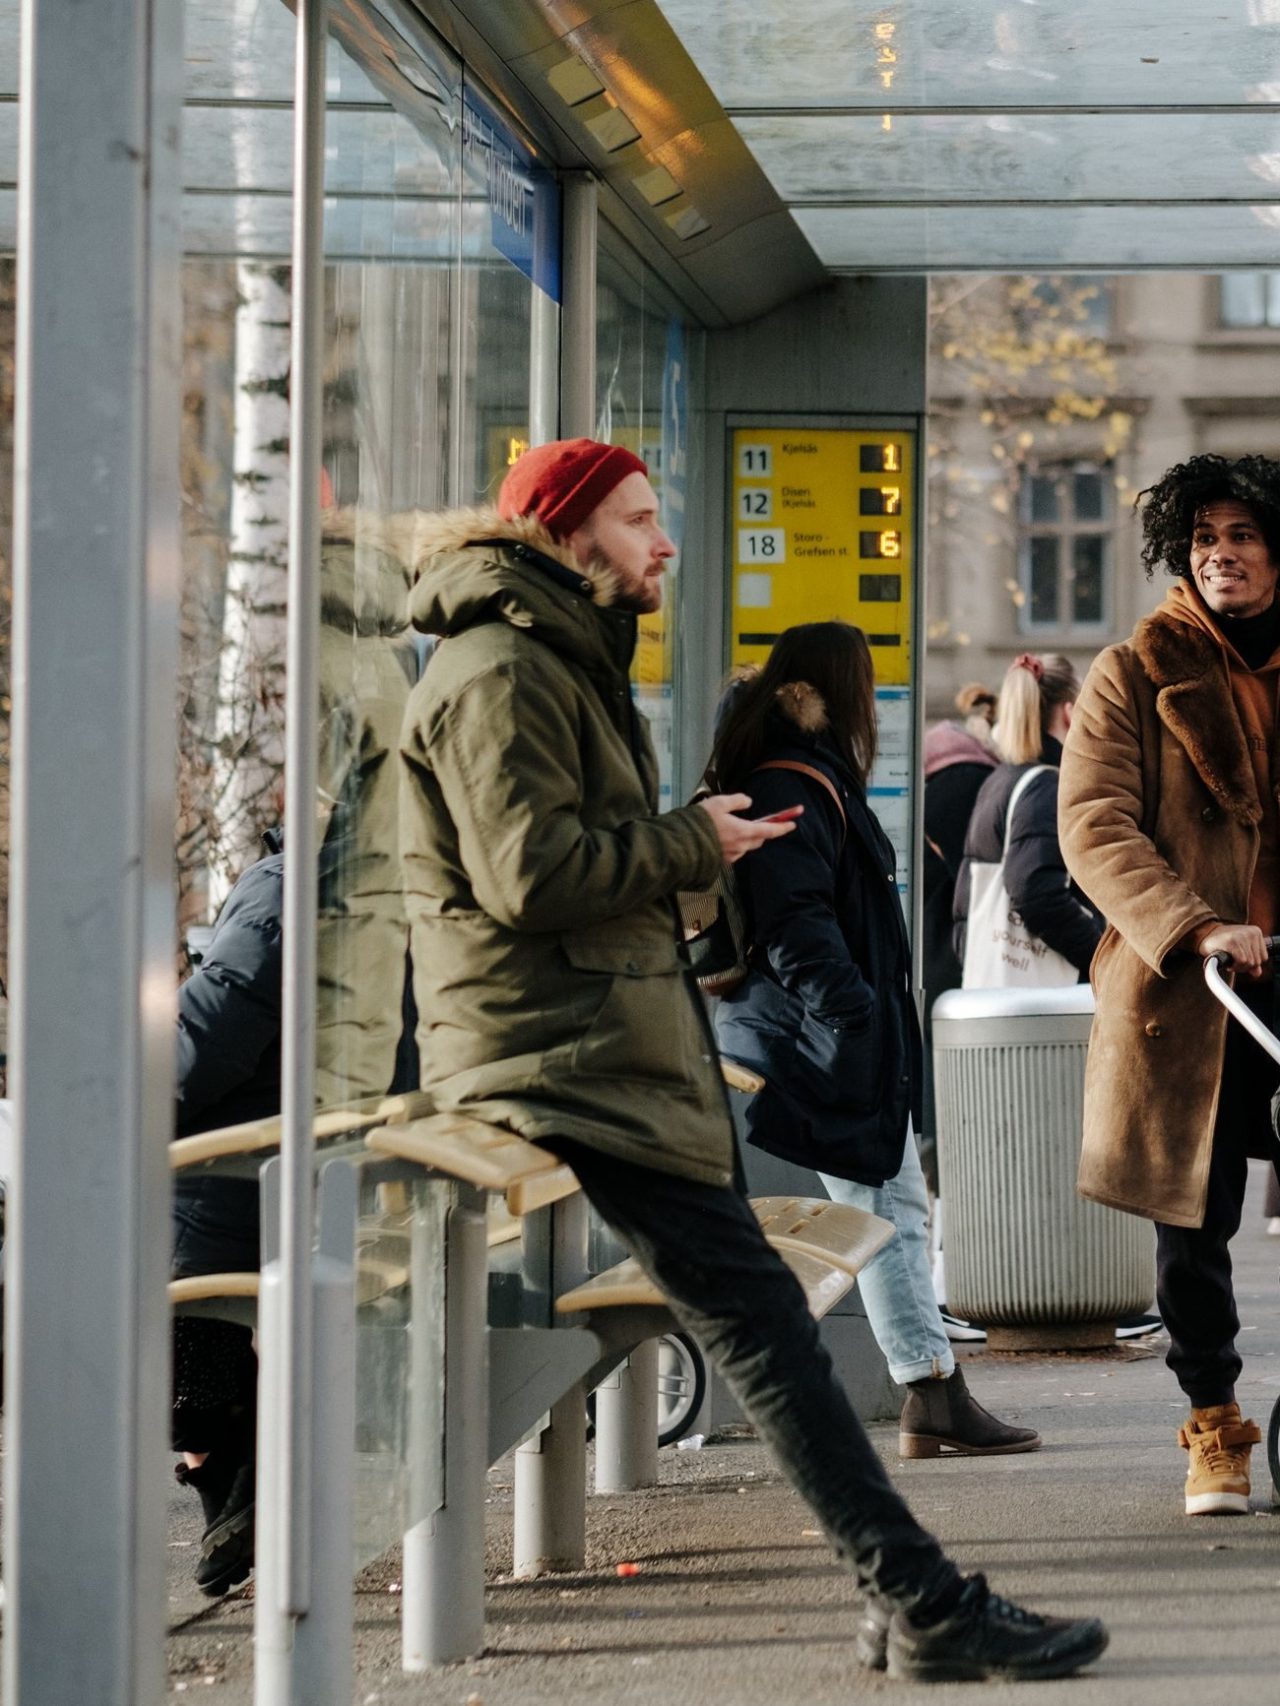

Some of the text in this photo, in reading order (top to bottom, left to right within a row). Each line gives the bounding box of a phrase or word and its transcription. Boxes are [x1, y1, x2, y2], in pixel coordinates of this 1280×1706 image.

[743, 449, 768, 471] 11
[883, 443, 898, 471] 1
[742, 493, 768, 515] 12
[880, 486, 900, 514] 7
[747, 535, 776, 557] 18
[793, 532, 823, 542] Storo
[880, 530, 900, 557] 6
[794, 546, 836, 557] Grefsen
